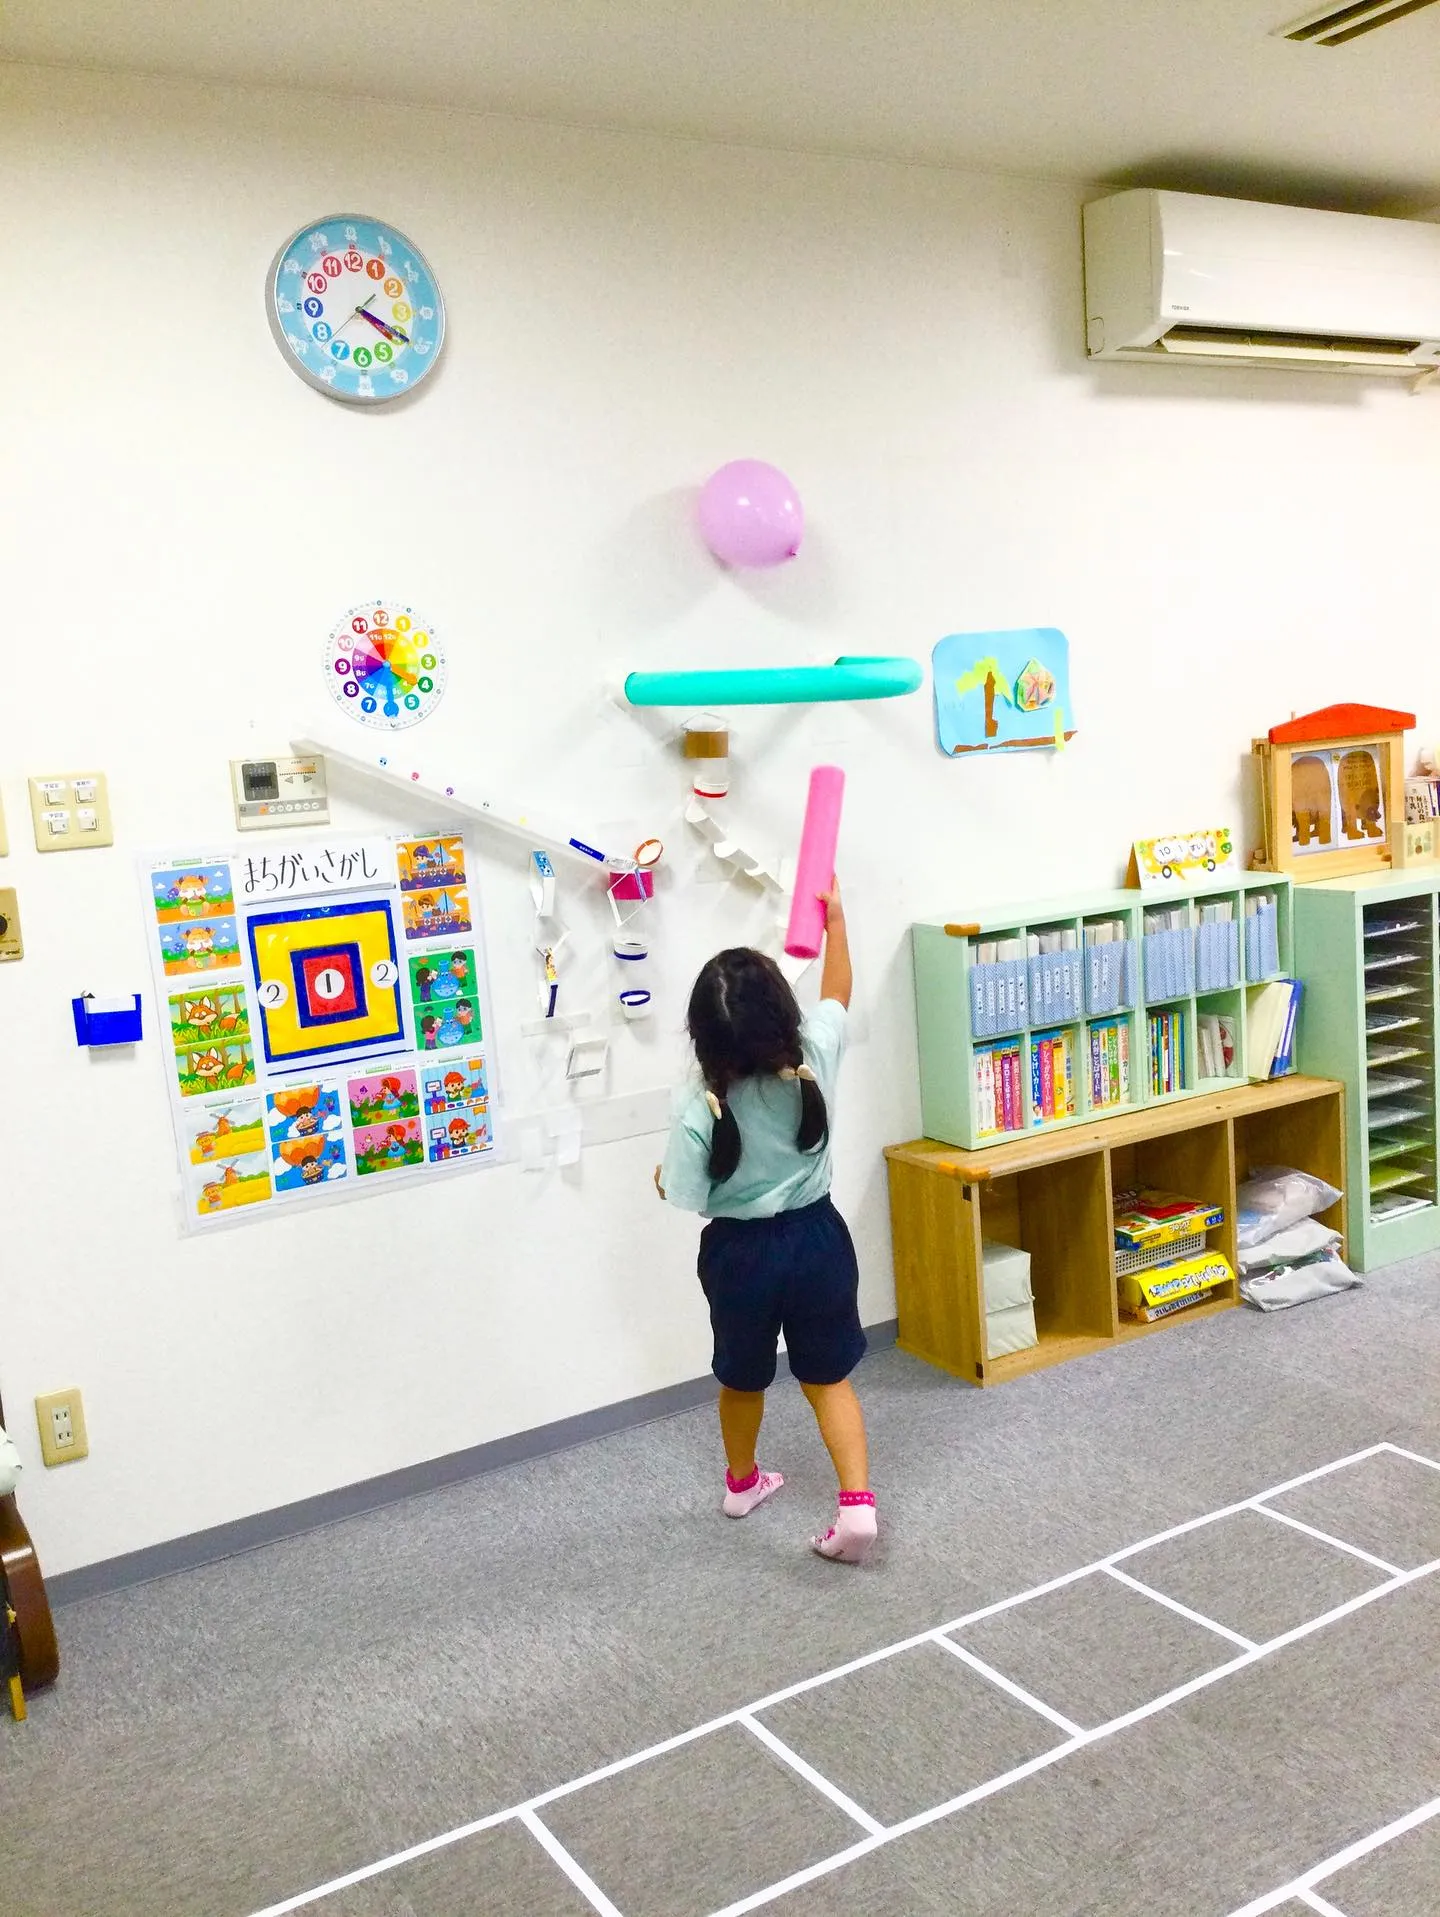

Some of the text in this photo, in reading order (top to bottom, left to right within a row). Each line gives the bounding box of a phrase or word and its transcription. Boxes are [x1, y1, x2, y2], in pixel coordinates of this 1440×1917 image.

[325, 260, 339, 277] 11
[344, 252, 362, 271] 12
[308, 276, 327, 293] 10
[388, 280, 400, 297] 2
[307, 299, 320, 318] 9
[396, 303, 407, 320] 3
[316, 323, 329, 340] 8
[335, 342, 347, 359] 7
[357, 348, 368, 365] 6
[379, 343, 389, 360] 5
[353, 620, 368, 632] 11
[374, 612, 389, 625] 12
[339, 637, 353, 649] 10
[338, 661, 347, 673] 9
[424, 656, 433, 668] 3
[346, 683, 356, 696] 8
[421, 679, 430, 690] 4
[365, 699, 373, 711] 7
[408, 697, 416, 708] 5
[1159, 846, 1171, 857] 10
[243, 847, 378, 893] まちがいさがし
[376, 963, 392, 982] 2
[325, 973, 332, 993] 1
[265, 984, 284, 1004] 2
[1032, 1053, 1040, 1100] とけいカード
